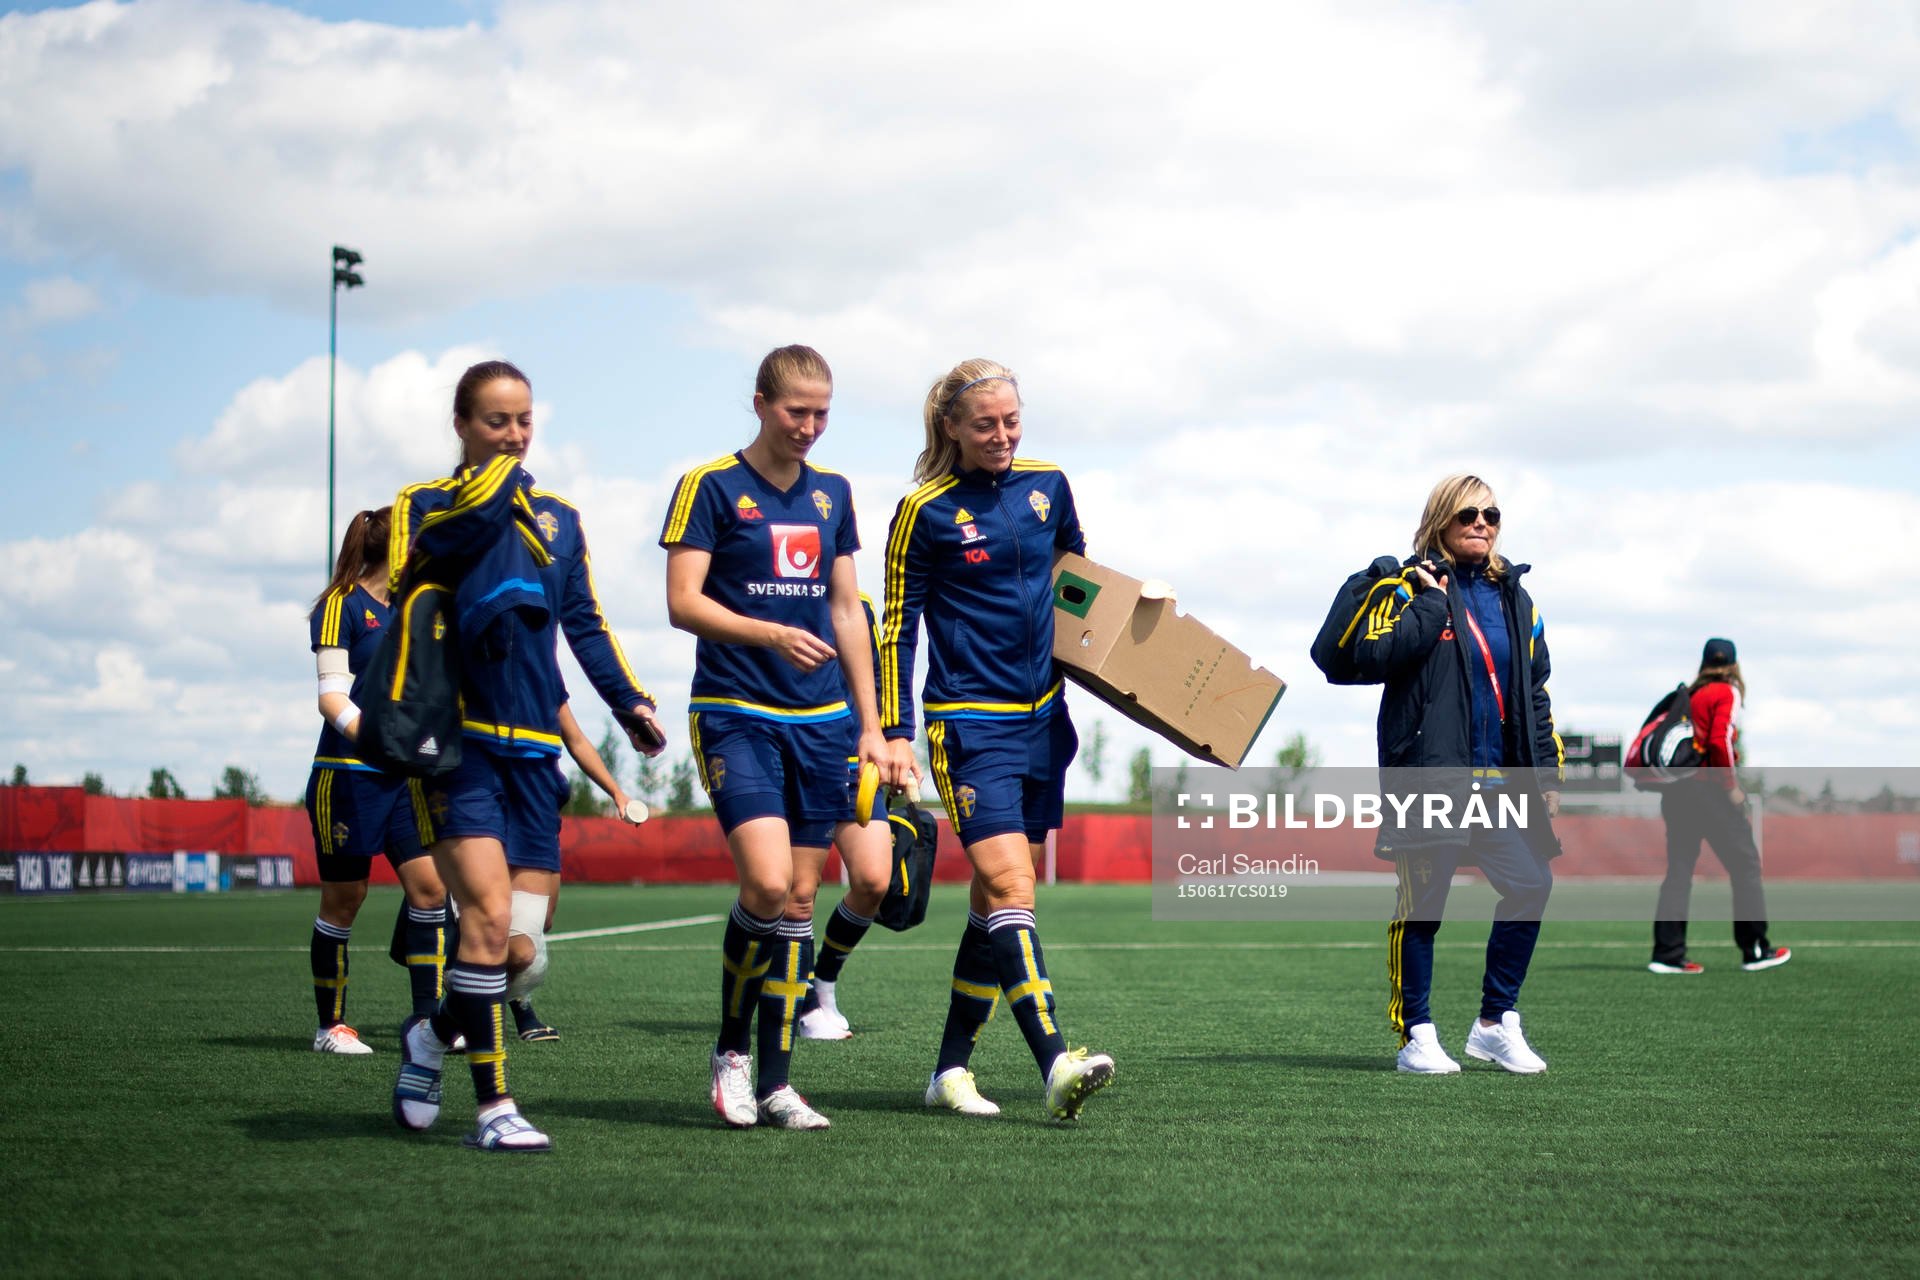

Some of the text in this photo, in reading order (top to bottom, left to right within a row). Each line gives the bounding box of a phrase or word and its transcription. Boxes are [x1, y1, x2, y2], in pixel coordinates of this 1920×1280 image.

[738, 508, 765, 520] ICA
[965, 549, 991, 563] ICA
[747, 583, 827, 598] SVENSKA SP
